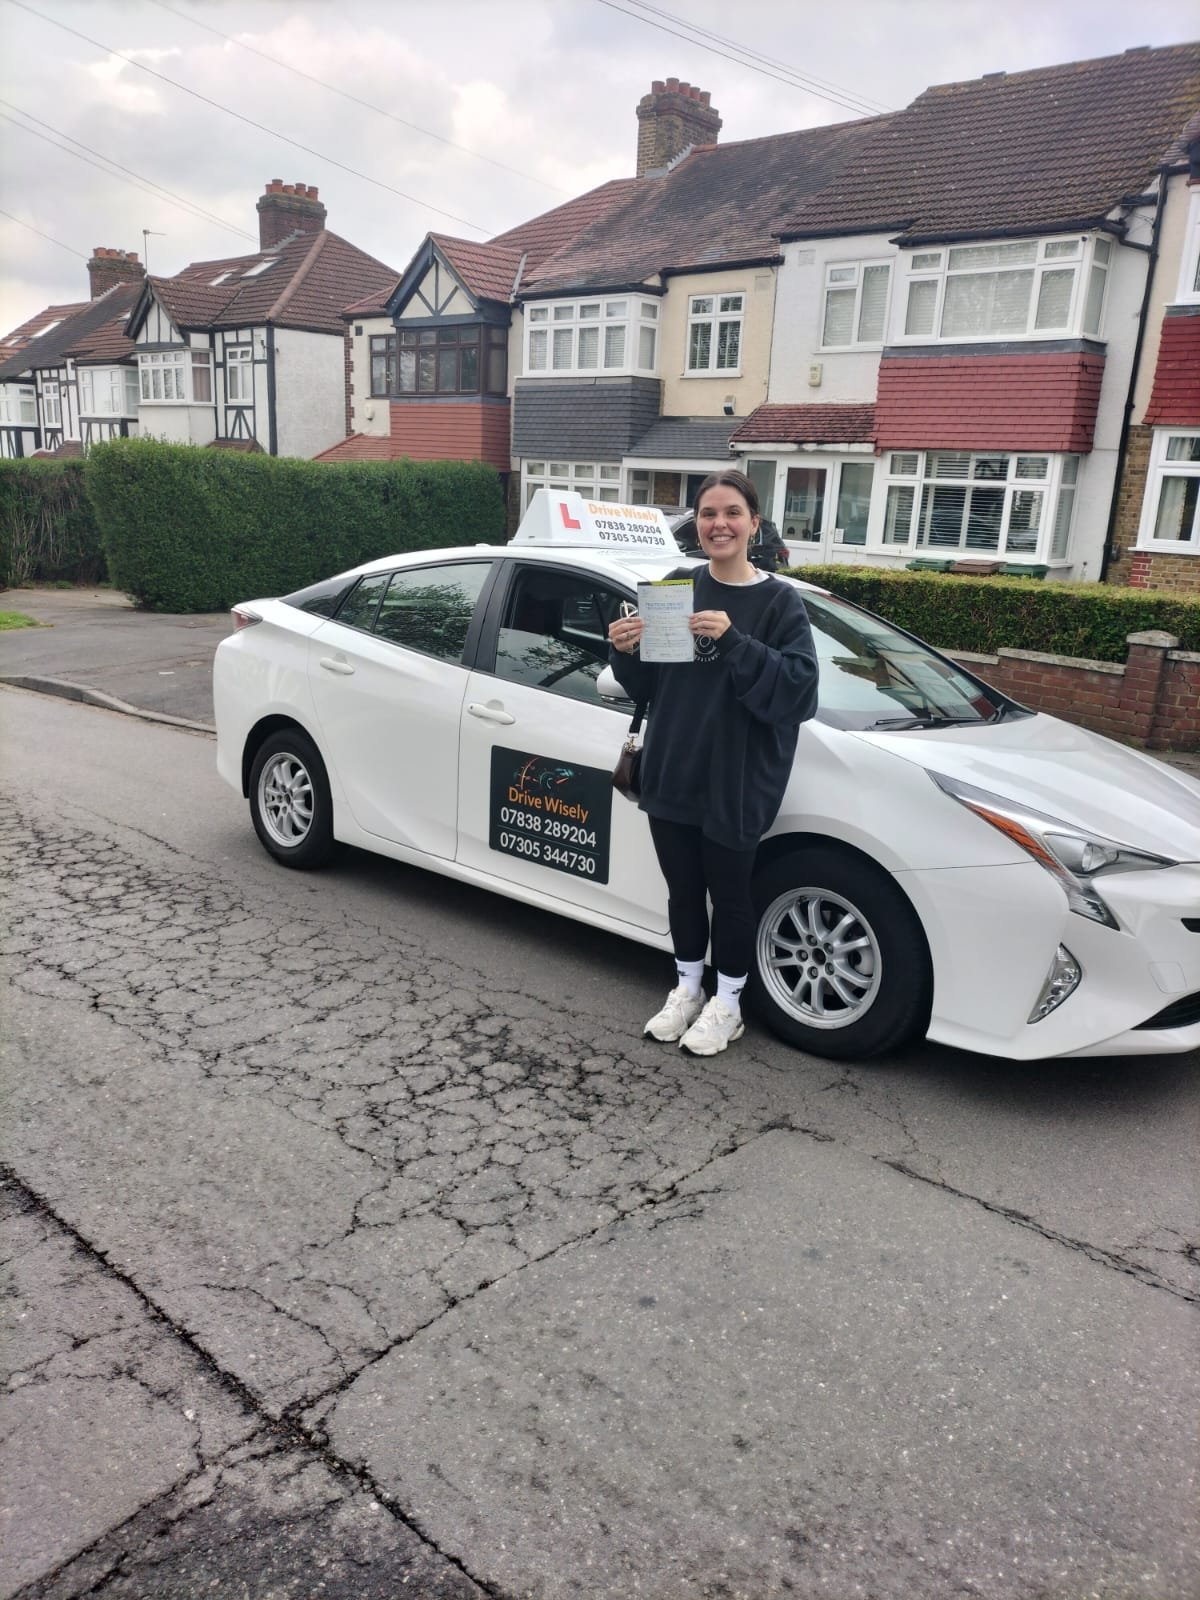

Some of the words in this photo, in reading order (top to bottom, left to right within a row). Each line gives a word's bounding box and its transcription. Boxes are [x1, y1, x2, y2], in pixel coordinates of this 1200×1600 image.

[559, 503, 581, 530] L
[588, 503, 621, 517] Drive
[621, 507, 658, 523] Wisely
[595, 520, 625, 531] 07838
[626, 523, 661, 535] 289204
[599, 531, 629, 543] 07305
[630, 535, 665, 546] 344730
[508, 786, 542, 809] Drive
[544, 796, 588, 824] Wisely
[500, 806, 541, 832] 07838
[543, 819, 597, 848] 289204
[500, 832, 540, 858] 07305
[543, 845, 595, 874] 344730
